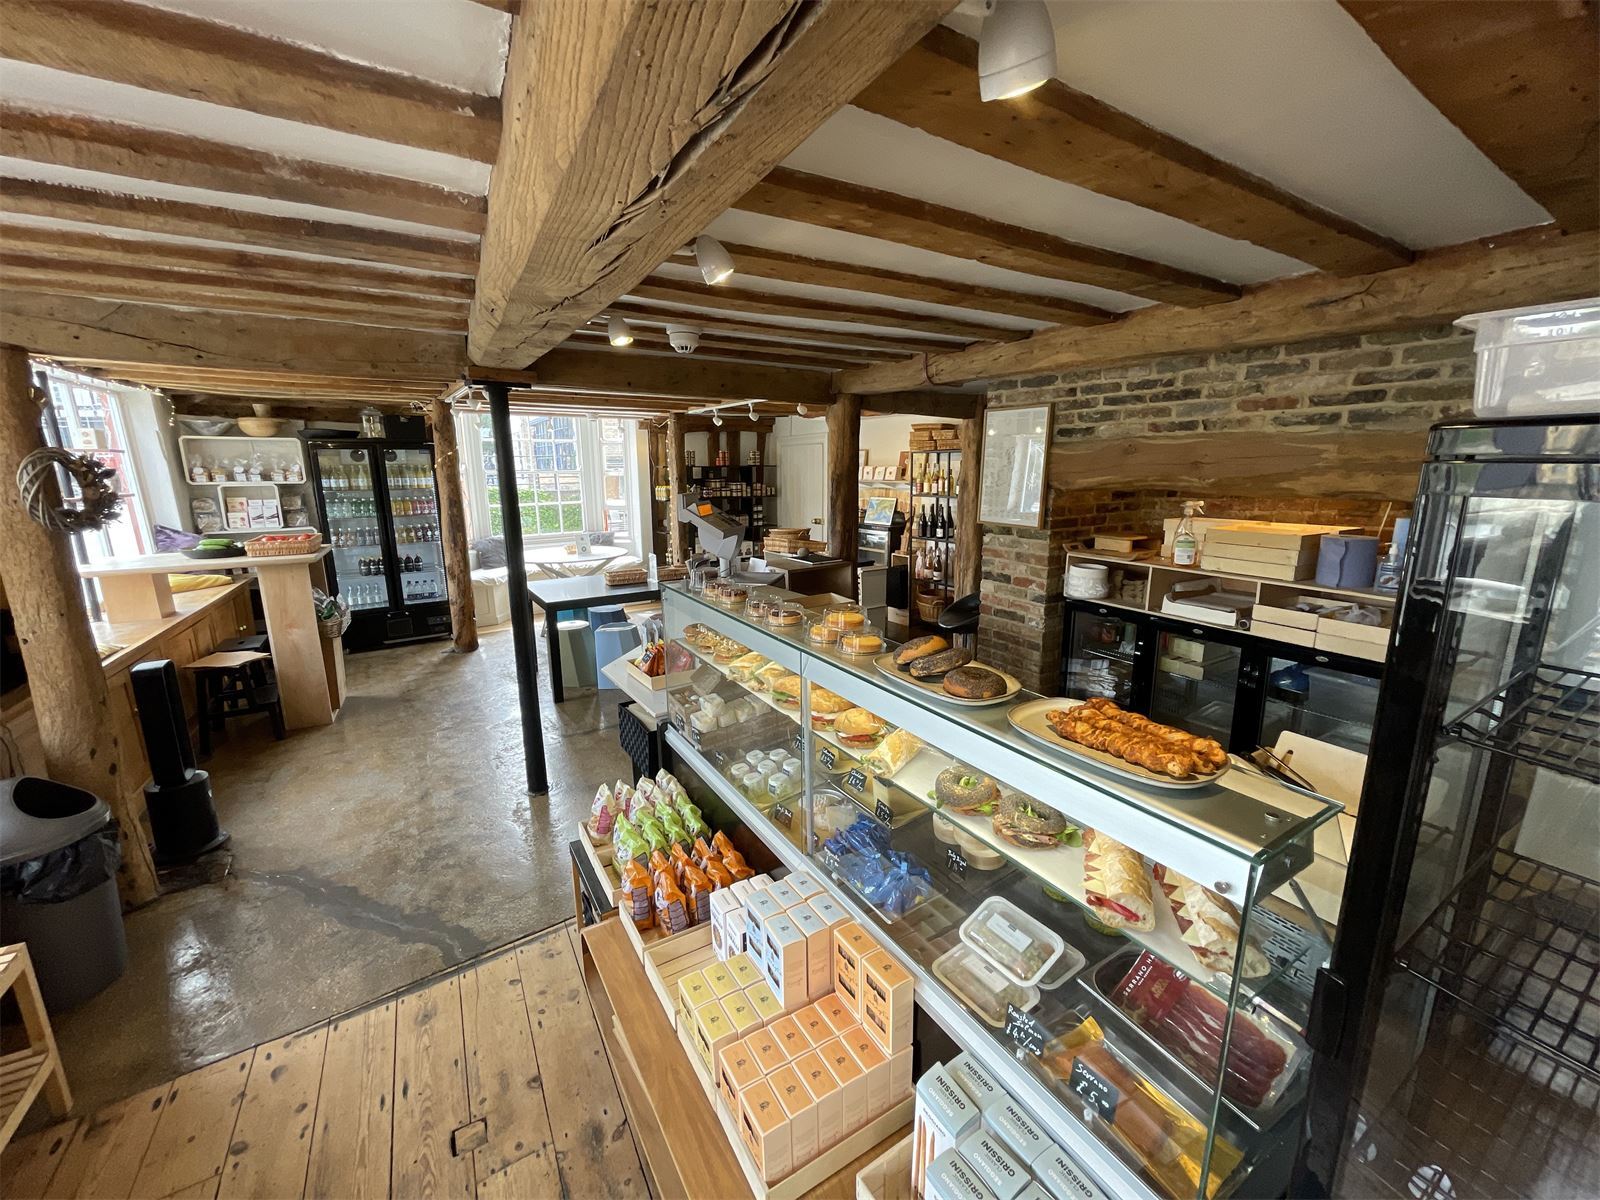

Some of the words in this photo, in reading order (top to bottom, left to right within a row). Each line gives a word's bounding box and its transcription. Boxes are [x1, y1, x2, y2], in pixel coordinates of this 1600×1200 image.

[1122, 964, 1147, 996] SERRANO
[1146, 953, 1156, 965] HA
[1007, 1004, 1036, 1027] Roasted
[935, 1075, 966, 1110] GRISSINI
[963, 1061, 994, 1092] GRISSINI
[1075, 1063, 1109, 1093] Serrano
[1006, 1105, 1040, 1141] GRISSINI
[980, 1140, 1016, 1177] GRISSINI
[949, 1160, 984, 1200] GRISSINI
[1047, 1168, 1079, 1200] EGGIANO
[1055, 1156, 1094, 1198] GRISSINI
